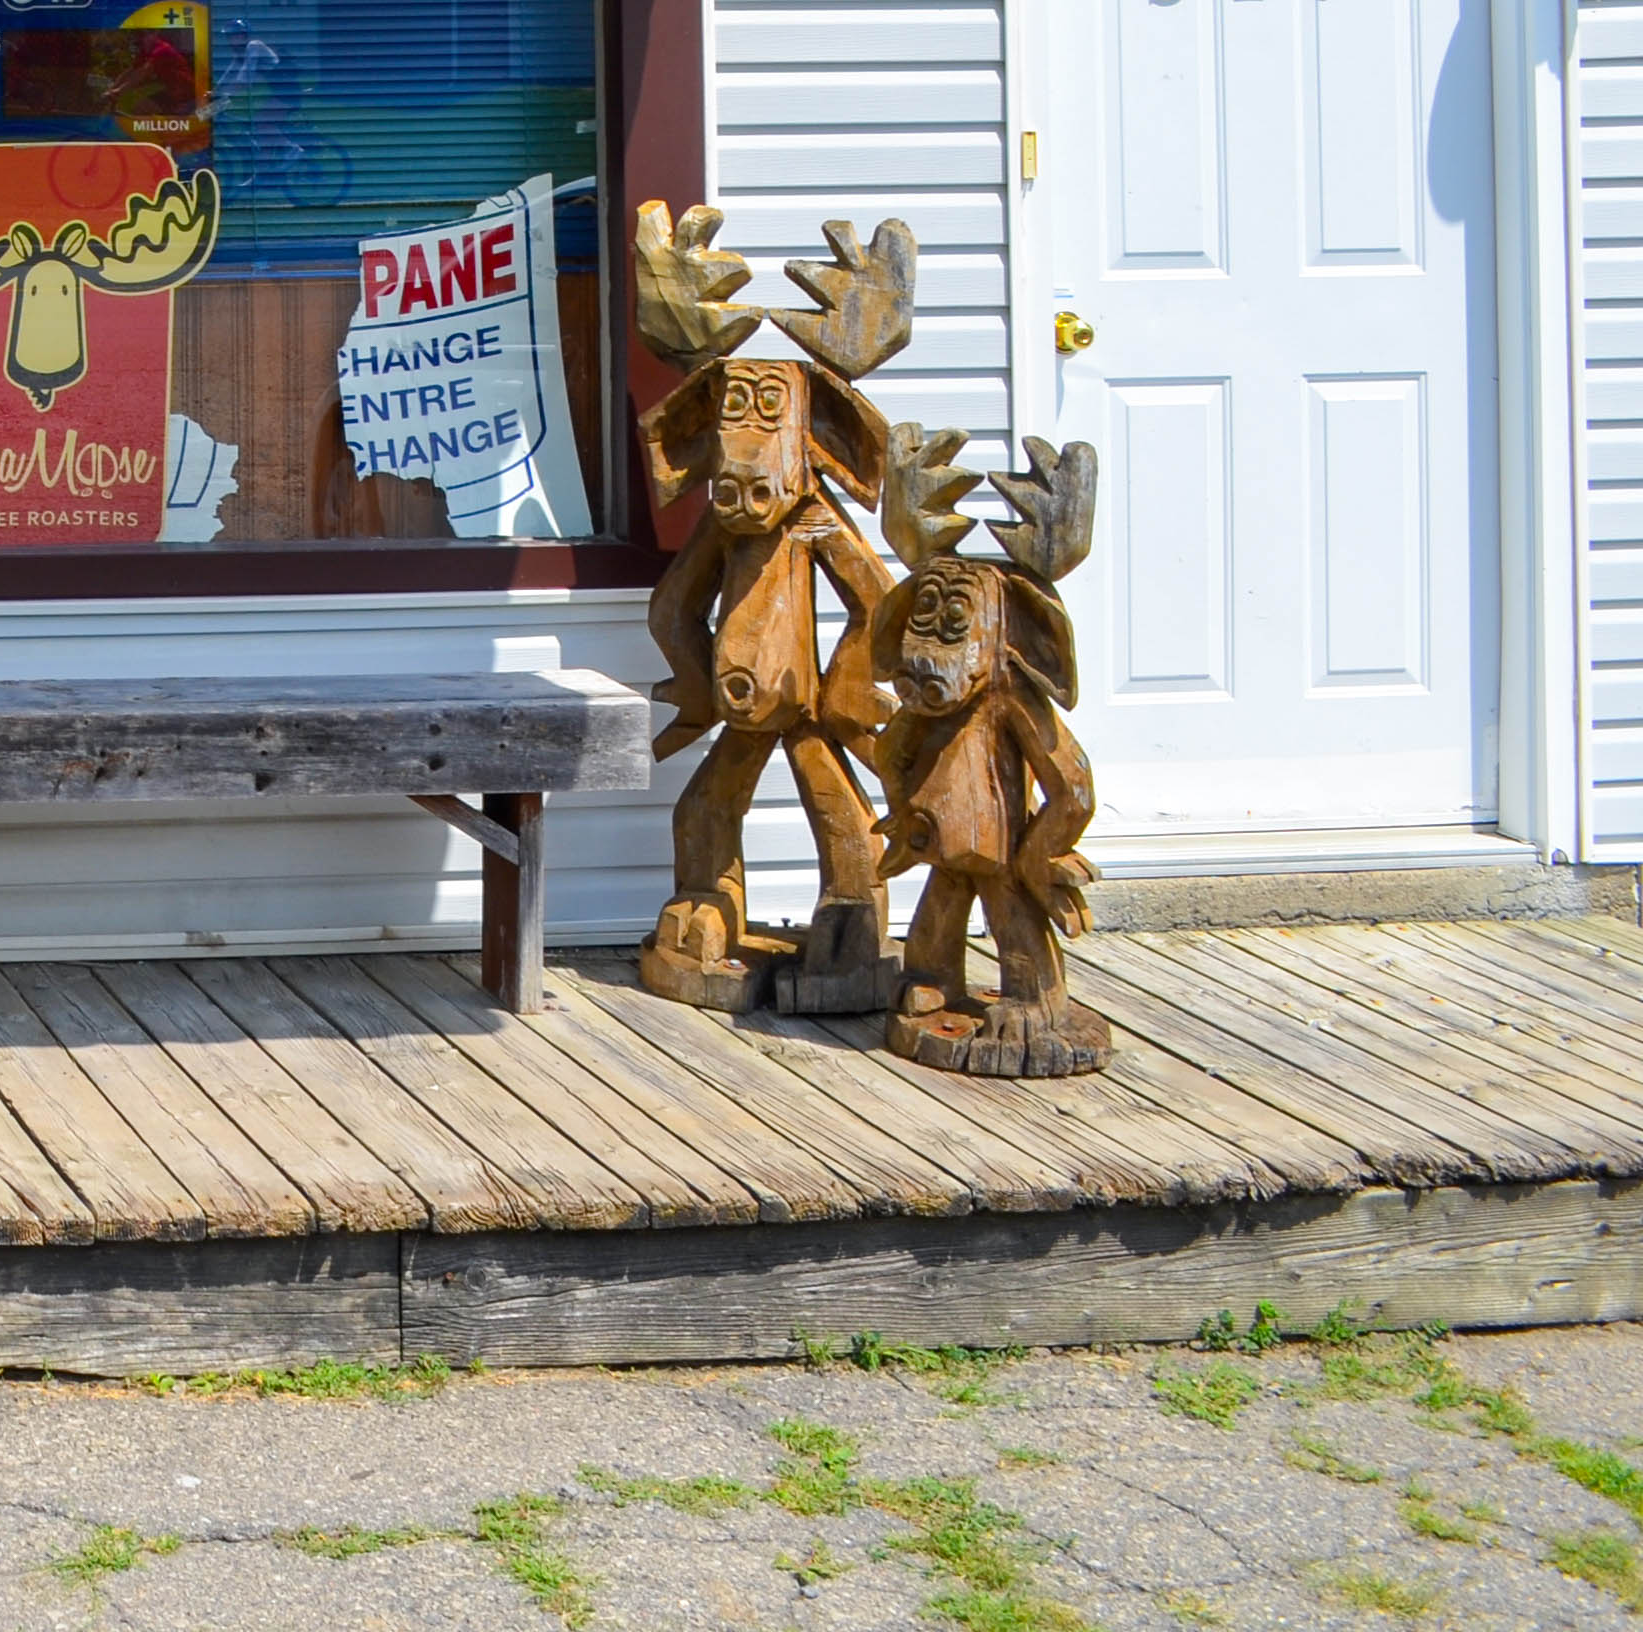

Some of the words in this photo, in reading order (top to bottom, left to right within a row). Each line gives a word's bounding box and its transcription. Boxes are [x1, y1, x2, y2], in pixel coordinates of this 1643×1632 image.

[133, 119, 190, 133] MILLION
[362, 223, 517, 319] PANE
[27, 510, 140, 527] ROASTERS
